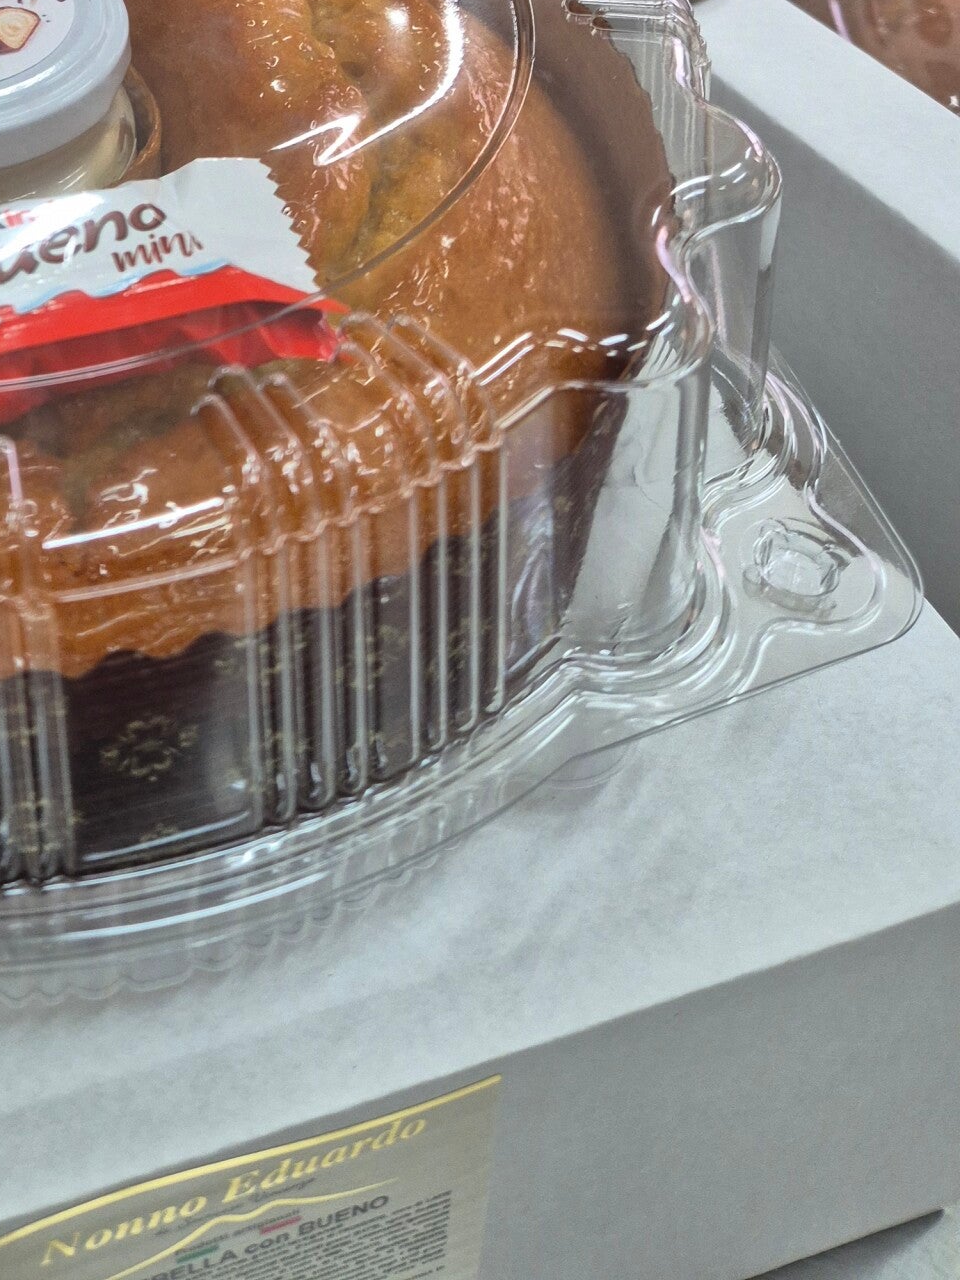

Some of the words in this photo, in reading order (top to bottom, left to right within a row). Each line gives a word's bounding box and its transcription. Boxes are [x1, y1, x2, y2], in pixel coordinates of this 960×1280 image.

[42, 1196, 208, 1266] Nonno
[222, 1119, 426, 1203] Eduardo
[244, 1232, 289, 1255] con
[298, 1195, 389, 1237] BUENO
